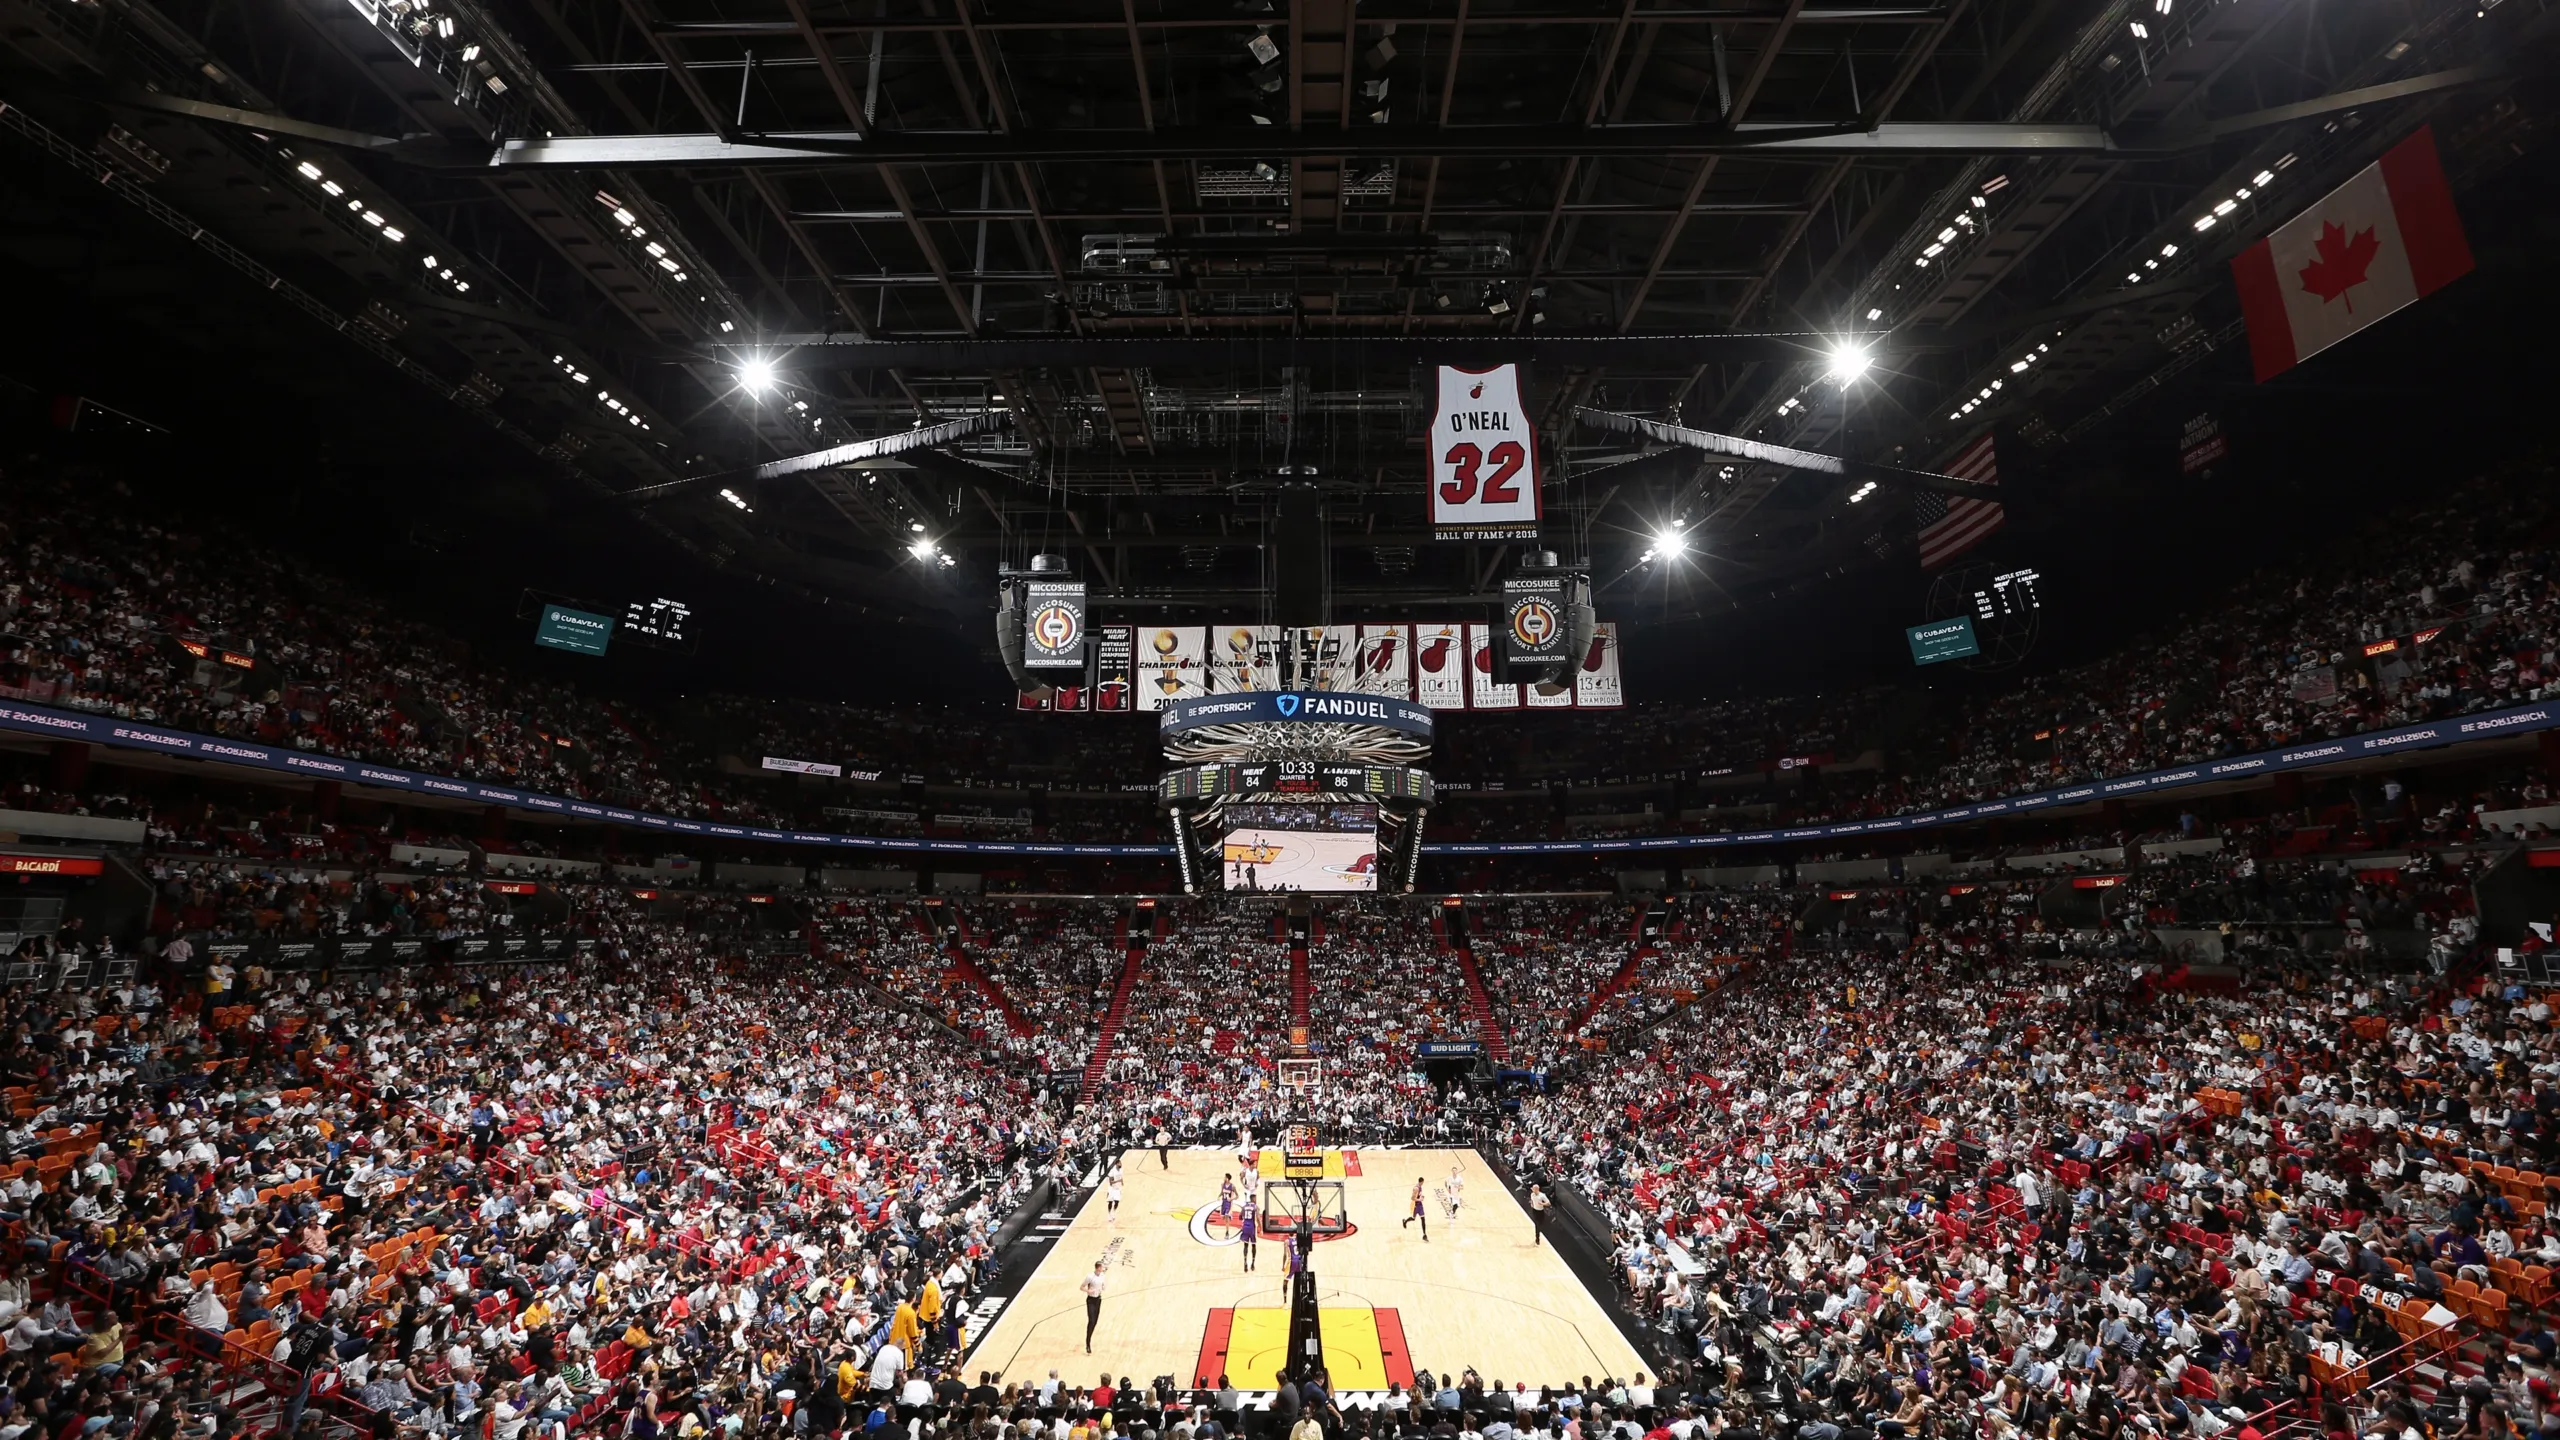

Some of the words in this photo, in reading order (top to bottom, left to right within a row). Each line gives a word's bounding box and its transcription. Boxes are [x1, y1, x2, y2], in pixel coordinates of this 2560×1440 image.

[1451, 411, 1509, 432] O'NEAL
[2184, 412, 2209, 435] MARC
[1440, 441, 1525, 504] 32
[1435, 532, 1460, 540] HALL
[1478, 531, 1504, 539] FAME
[1516, 530, 1537, 539] 2016
[2015, 568, 2033, 577] STATS
[1029, 584, 1085, 592] MICCOSUKEE
[1505, 580, 1560, 588] MICCOSUKEE
[1031, 599, 1082, 619] MICCOSUKEE
[1509, 595, 1561, 616] MICCOSUKEE
[1028, 632, 1050, 655] RESORT
[1058, 631, 1083, 655] GAMING
[1508, 629, 1532, 651] RESORT
[1541, 627, 1563, 651] GAMING
[2366, 640, 2396, 656] BACARDÍ
[1421, 679, 1436, 692] 10
[1448, 679, 1459, 692] 11
[1476, 679, 1488, 691] 11
[1580, 677, 1593, 690] 13
[1606, 677, 1618, 690] 14
[1476, 698, 1517, 706] CHAMPIONS
[1530, 697, 1570, 705] CHAMPIONS
[1579, 696, 1621, 704] CHAMPIONS
[1188, 708, 1197, 717] BE
[1304, 698, 1389, 719] FANDUEL
[1398, 709, 1407, 719] BE
[1795, 757, 1809, 766] SUN
[811, 767, 835, 775] Carnival
[1200, 763, 1221, 772] MIAMI
[1242, 766, 1267, 776] HEAT
[1279, 761, 1316, 774] 10:33
[1323, 767, 1362, 775] LAKERS
[1701, 767, 1733, 777] LAKERS
[850, 770, 883, 781] HEAT
[1246, 777, 1260, 787] 84
[1335, 777, 1349, 787] 86
[1173, 816, 1191, 884] MICCOSUKEE.COM
[1408, 817, 1425, 884] MICCOSUKEE.COM
[15, 860, 61, 872] BACARDÍ
[1448, 1044, 1472, 1052] LIGHT
[1244, 1210, 1253, 1220] 15
[2384, 1294, 2397, 1305] 32
[295, 1335, 314, 1356] 24
